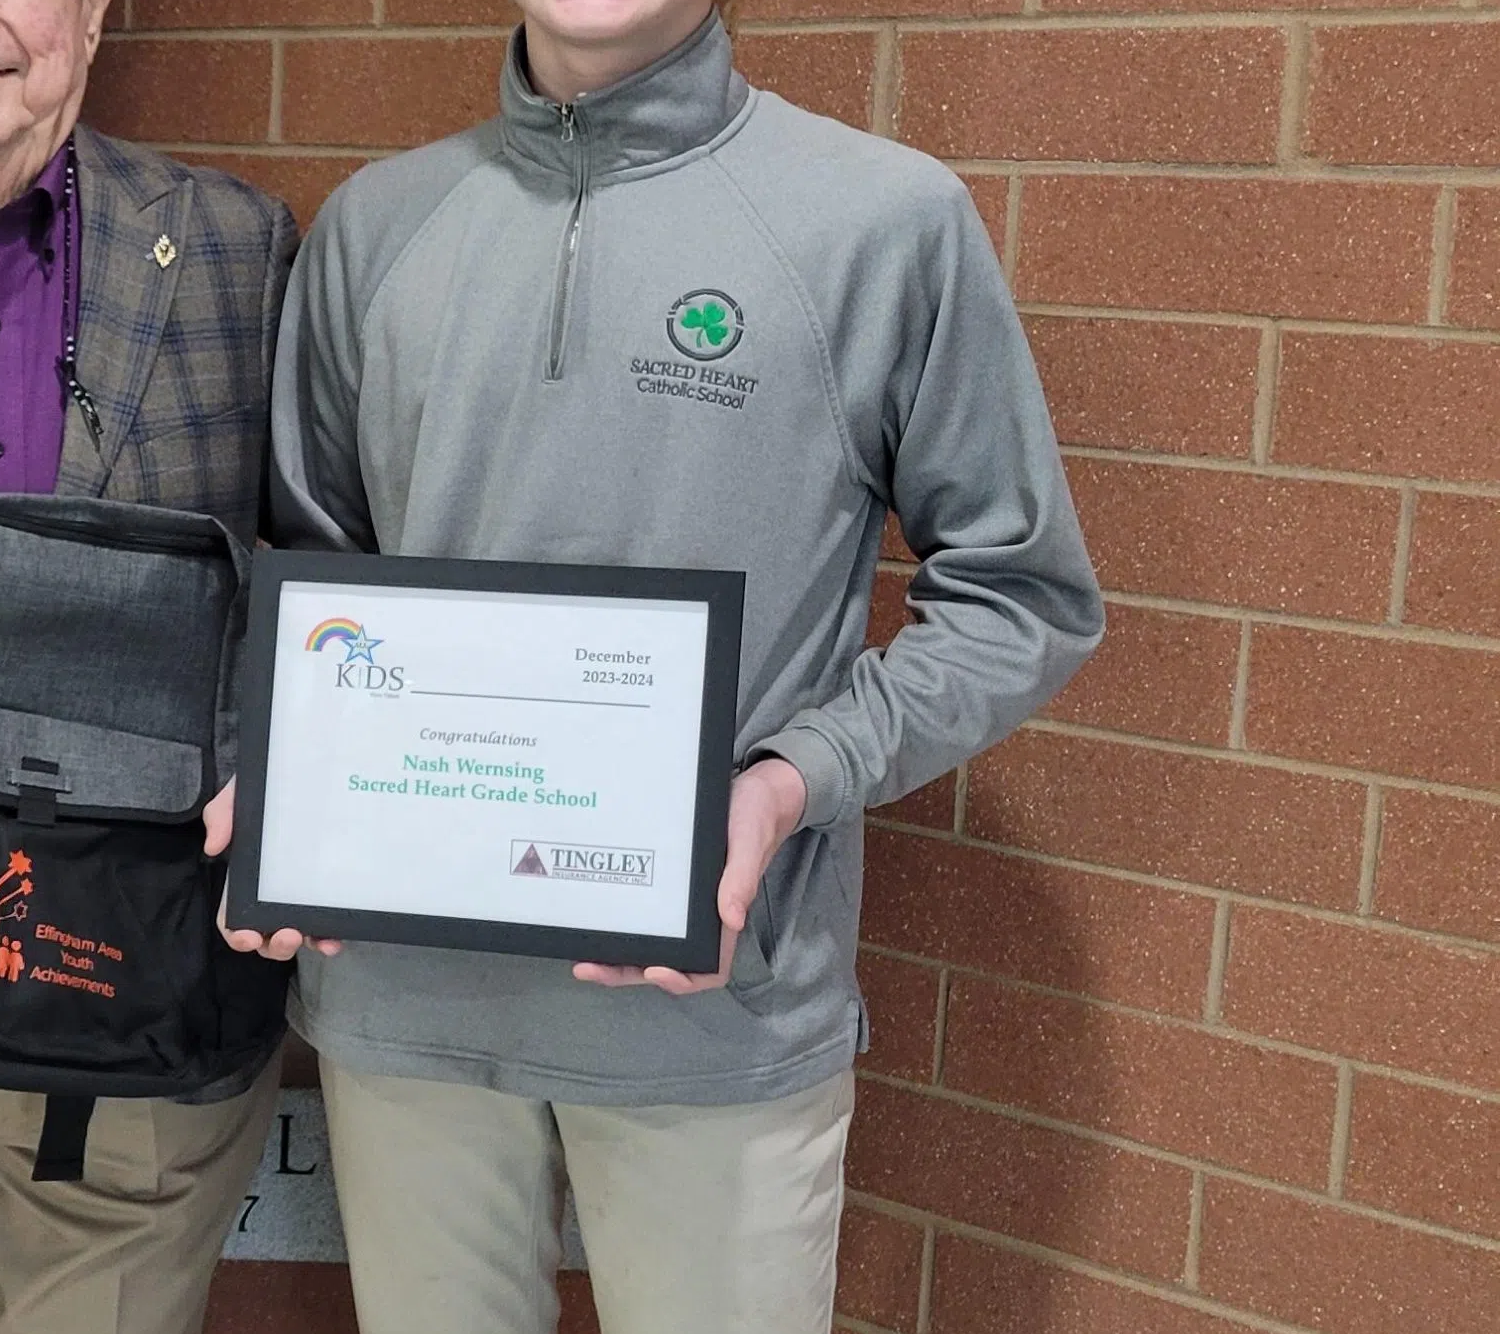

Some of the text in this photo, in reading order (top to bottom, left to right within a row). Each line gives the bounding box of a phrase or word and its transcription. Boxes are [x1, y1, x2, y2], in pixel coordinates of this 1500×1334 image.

[630, 358, 759, 395] SACRED HEART
[636, 377, 746, 410] Catholic School
[575, 648, 651, 665] December
[335, 663, 404, 692] KIDS
[582, 670, 654, 687] 2023-2024
[419, 727, 538, 748] Congratulations
[402, 754, 545, 784] Nash Wernsing
[348, 774, 598, 809] Sacred Heart Grade School
[550, 848, 652, 874] TINGLEY
[35, 923, 123, 962] Effingham Area
[60, 949, 94, 971] Youth
[29, 965, 116, 998] Achievements
